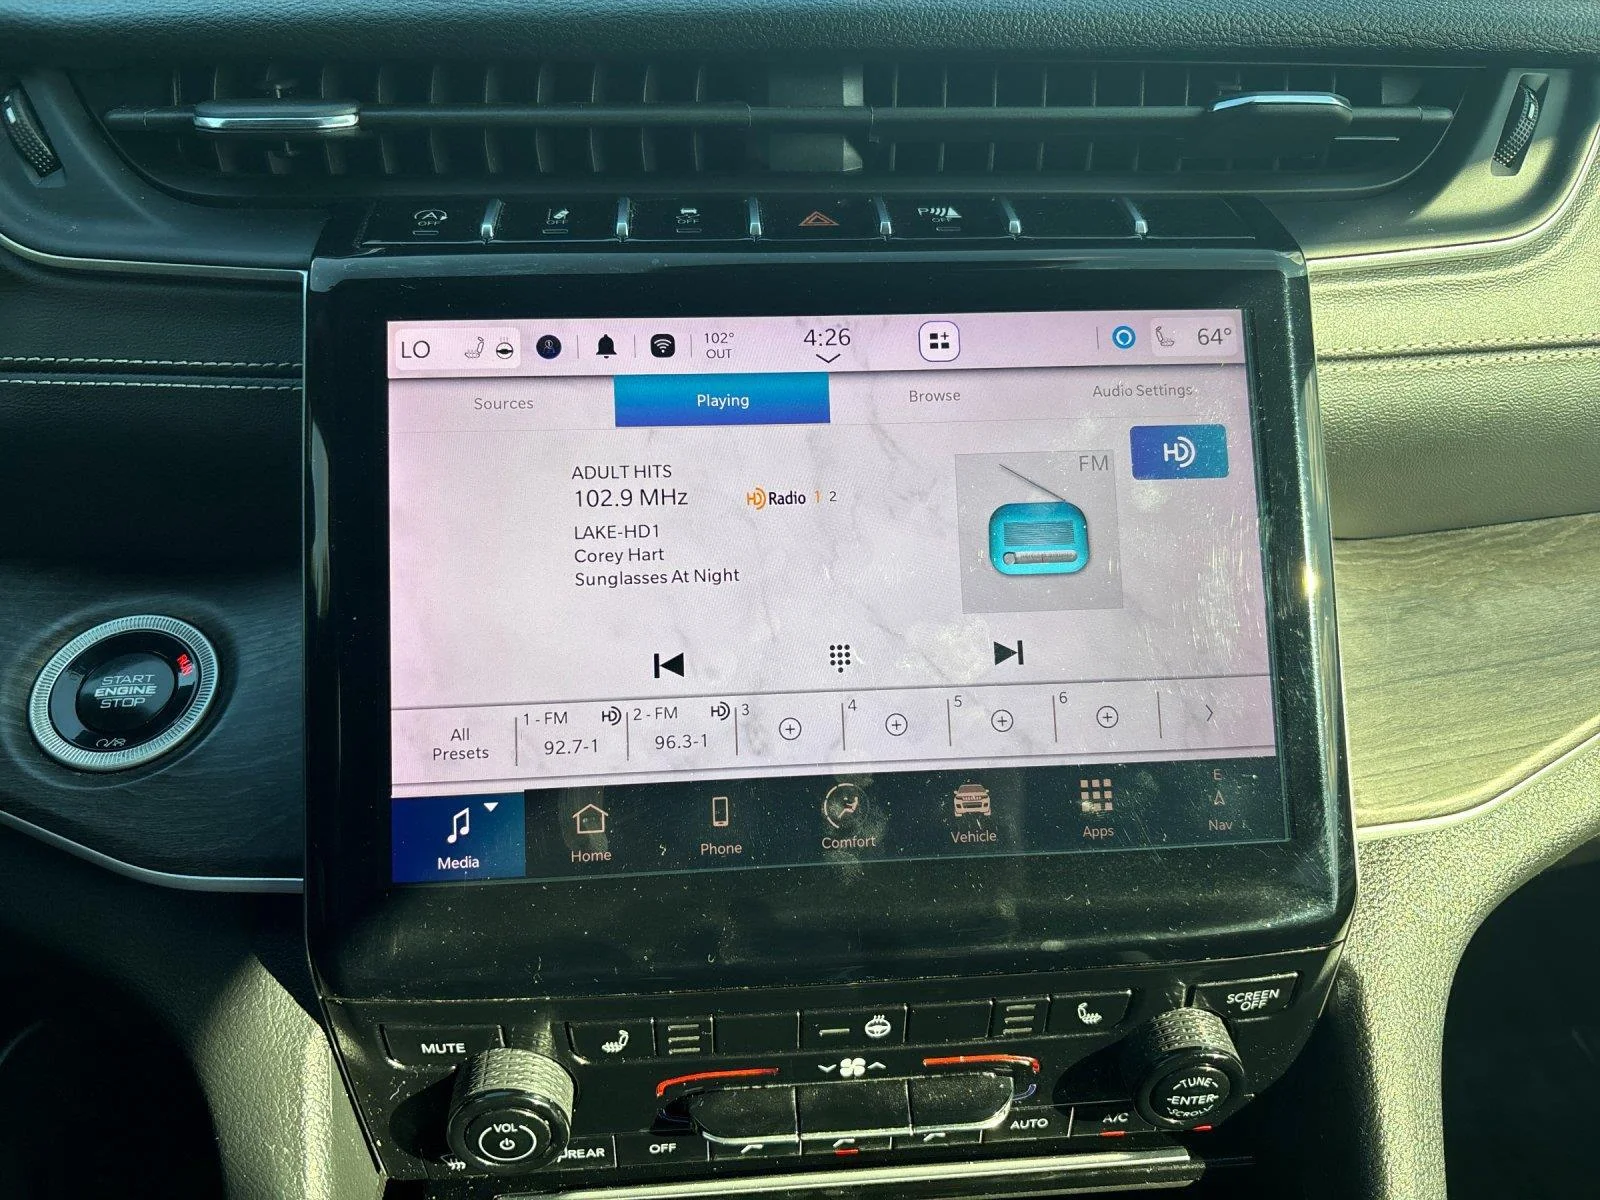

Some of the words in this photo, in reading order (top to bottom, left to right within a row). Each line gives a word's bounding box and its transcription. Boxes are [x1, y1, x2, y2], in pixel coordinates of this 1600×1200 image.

[704, 331, 735, 345] 102°
[803, 327, 852, 347] 4:26
[1197, 327, 1232, 346] 64°
[401, 340, 431, 359] LO
[706, 347, 734, 360] OUT
[909, 389, 962, 403] Browse
[1092, 384, 1133, 398] Audio
[1135, 382, 1193, 400] Settings
[473, 396, 535, 412] Sources
[697, 393, 750, 411] Playing
[1079, 455, 1110, 472] FM
[571, 465, 630, 480] ADULT
[634, 464, 673, 479] HITS
[575, 488, 633, 508] 102.9
[640, 488, 689, 506] MHz
[768, 490, 807, 506] Radio
[814, 490, 821, 503] 1
[829, 490, 838, 503] 2
[574, 524, 660, 540] LAKE-HD1
[574, 549, 624, 565] Corey
[628, 547, 665, 562] Hart
[575, 570, 668, 589] Sunglasses
[671, 570, 690, 584] At
[694, 568, 741, 586] Night
[101, 674, 155, 686] START
[94, 685, 157, 697] ENGINE
[1058, 691, 1068, 705] 6
[100, 697, 146, 709] STOP
[847, 698, 858, 713] 4
[954, 695, 963, 708] 5
[633, 708, 642, 722] 2
[655, 706, 679, 720] FM
[741, 703, 750, 717] 3
[523, 712, 531, 726] 1
[544, 711, 569, 726] FM
[450, 727, 470, 742] All
[655, 733, 708, 750] 96.3-1
[433, 746, 490, 761] Presets
[544, 738, 598, 756] 92.7-1
[1213, 768, 1223, 781] E
[1083, 825, 1115, 840] Apps
[1208, 819, 1233, 831] Nav
[821, 835, 877, 850] Comfort
[950, 828, 998, 844] Vehicle
[571, 848, 613, 863] Home
[700, 842, 743, 857] Phone
[437, 856, 480, 871] Media
[1227, 987, 1280, 1004] SCREEN
[1240, 999, 1267, 1012] OFF
[421, 1042, 467, 1054] MUTE
[1010, 1118, 1049, 1131] AUTO
[1102, 1112, 1129, 1123] A/C
[493, 1123, 519, 1134] VOL
[568, 1147, 605, 1159] REAR
[649, 1142, 677, 1154] OFF
